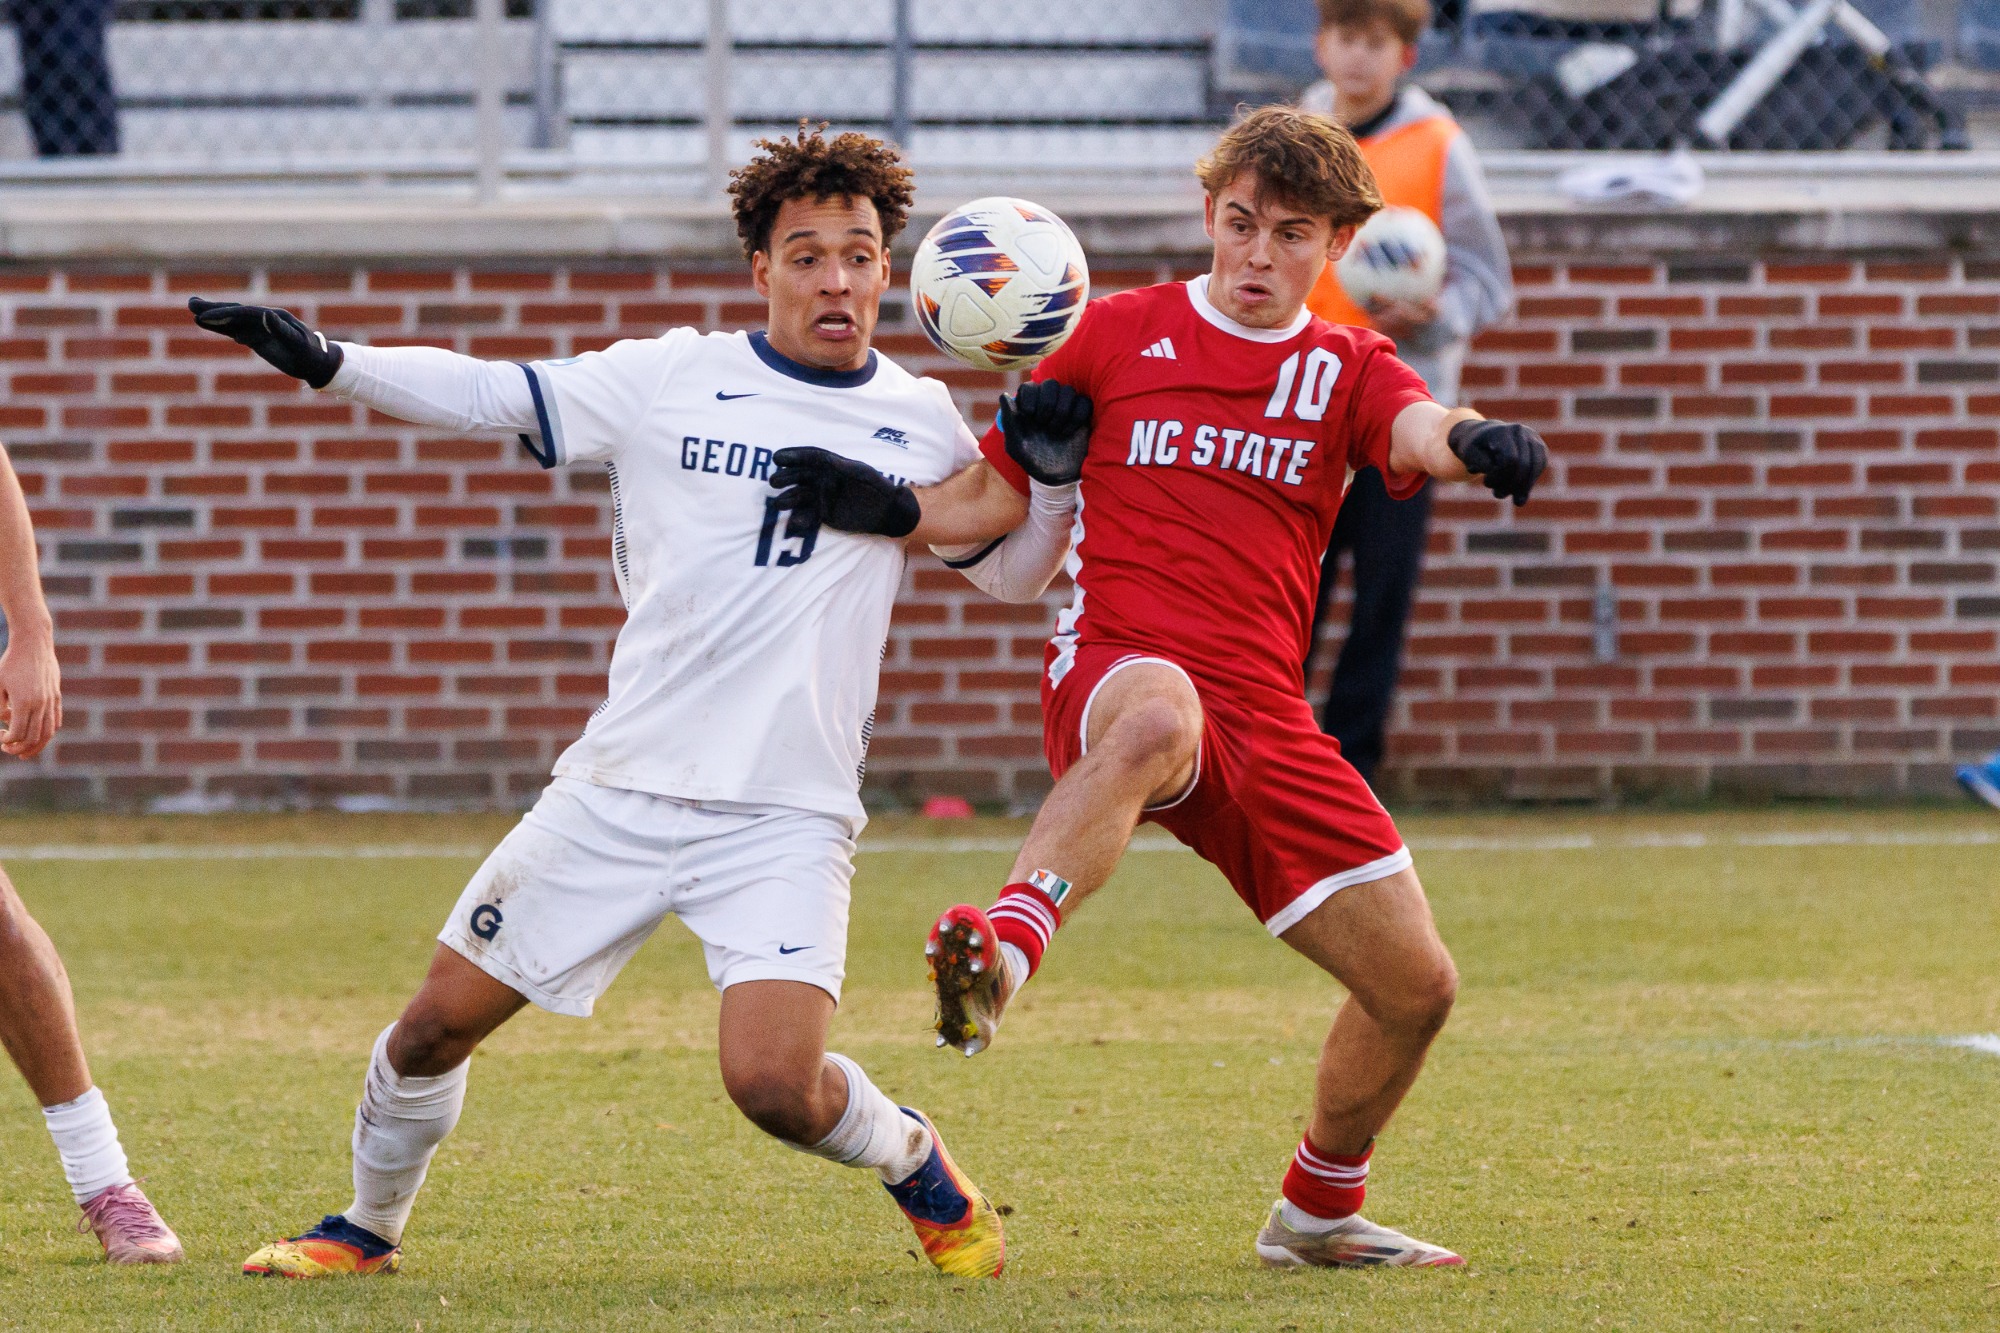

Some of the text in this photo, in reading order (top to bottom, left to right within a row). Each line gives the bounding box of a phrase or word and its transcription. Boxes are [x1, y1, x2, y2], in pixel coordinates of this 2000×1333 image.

[1263, 346, 1343, 422] 10
[877, 426, 906, 438] BIG
[1126, 419, 1317, 486] NC STATE
[470, 904, 503, 943] G
